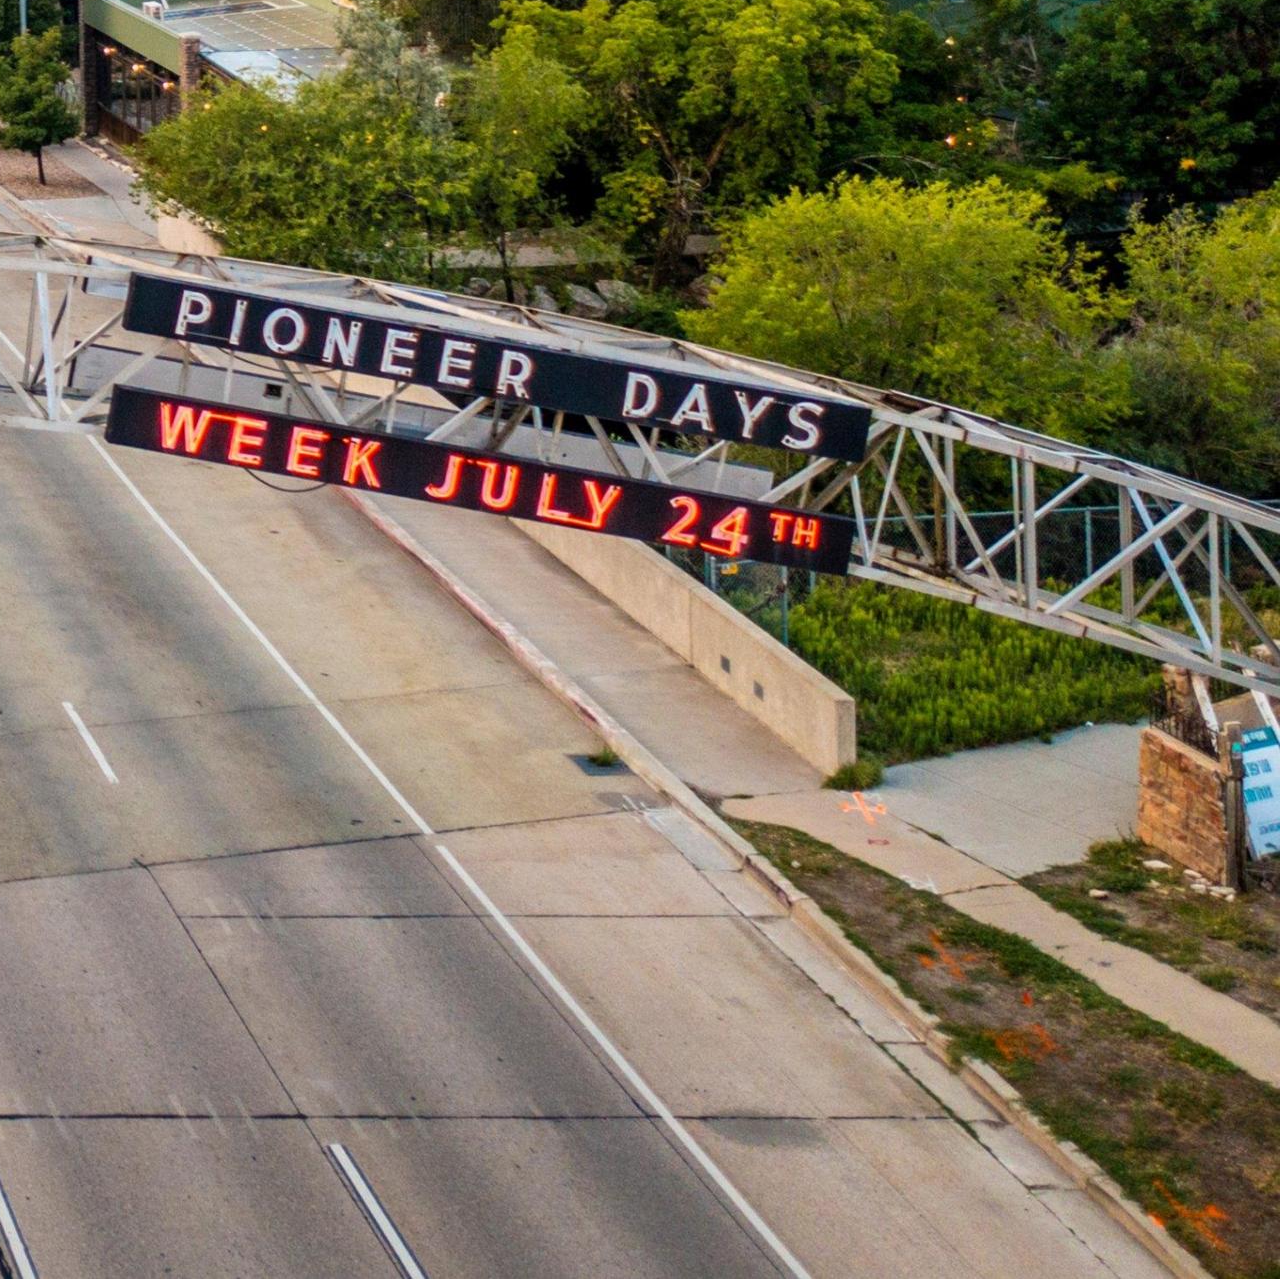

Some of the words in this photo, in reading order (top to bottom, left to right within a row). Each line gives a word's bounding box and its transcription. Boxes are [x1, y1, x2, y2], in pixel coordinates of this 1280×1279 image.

[175, 289, 534, 401] PIONEER
[623, 371, 826, 452] DAYS
[159, 401, 381, 488] WEEK
[425, 453, 623, 529] JULY
